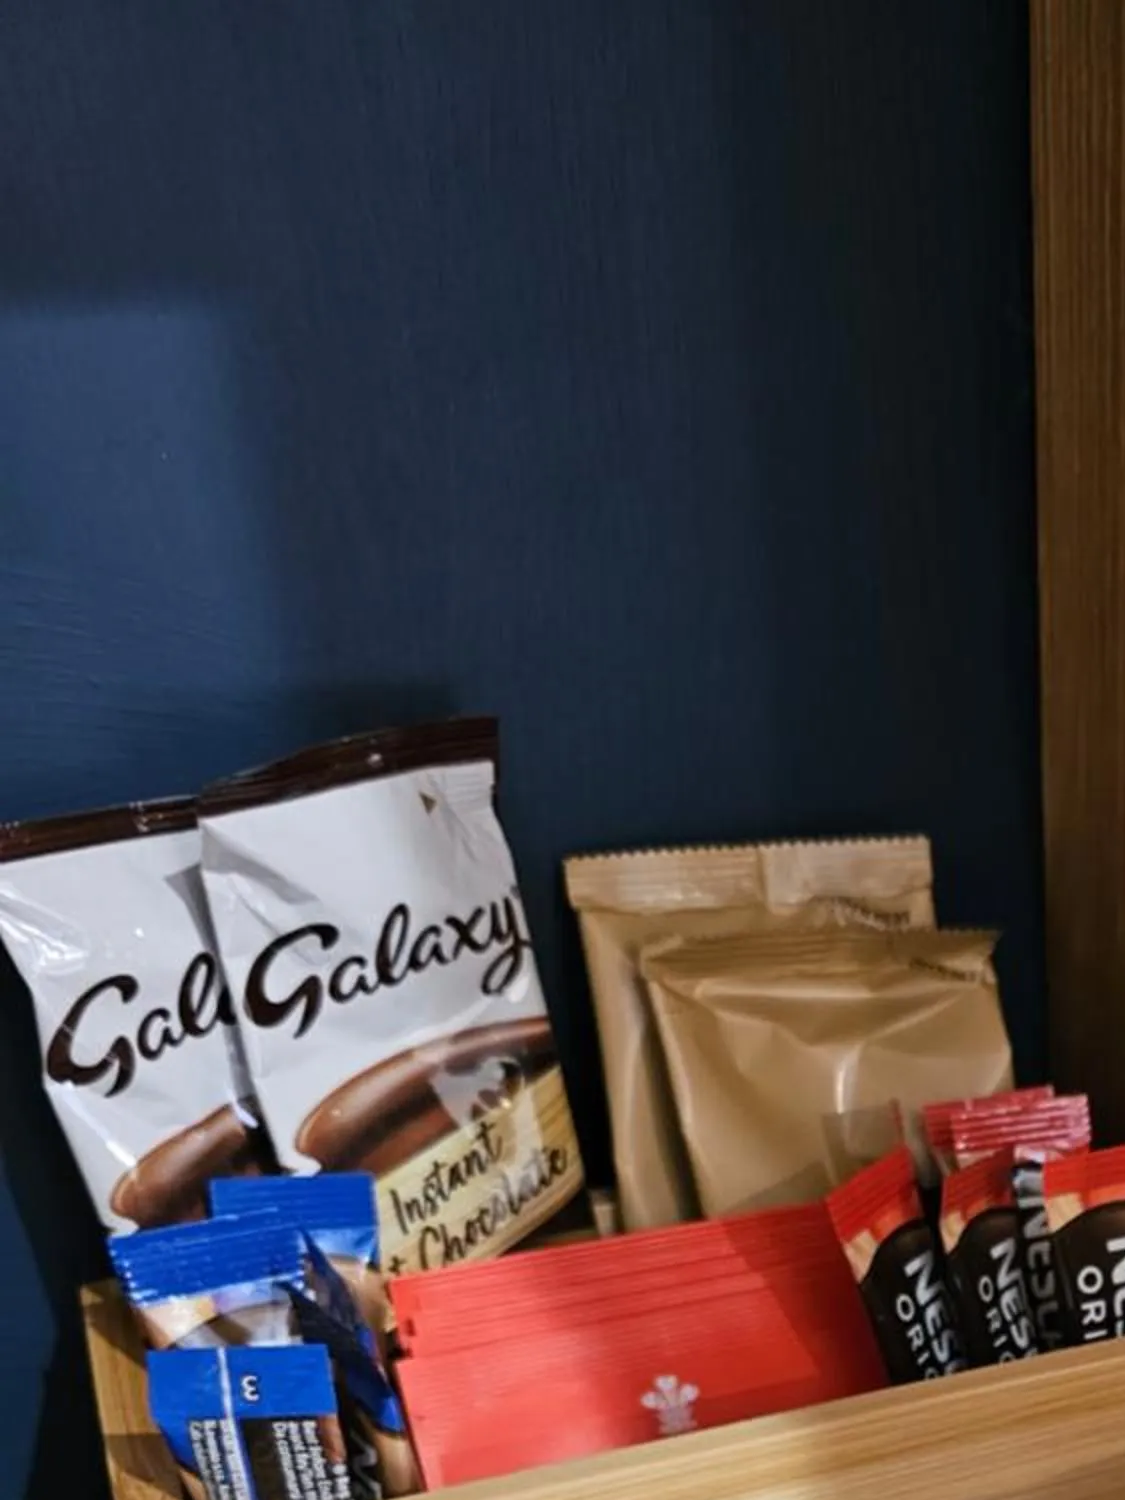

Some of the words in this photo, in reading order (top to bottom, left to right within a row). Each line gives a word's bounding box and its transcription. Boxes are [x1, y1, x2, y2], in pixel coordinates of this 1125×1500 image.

[245, 897, 532, 1040] Galaxy
[390, 1121, 503, 1236] Instant
[419, 1147, 567, 1271] Chocolate
[904, 1251, 960, 1376] NES
[990, 1237, 1040, 1362] NES
